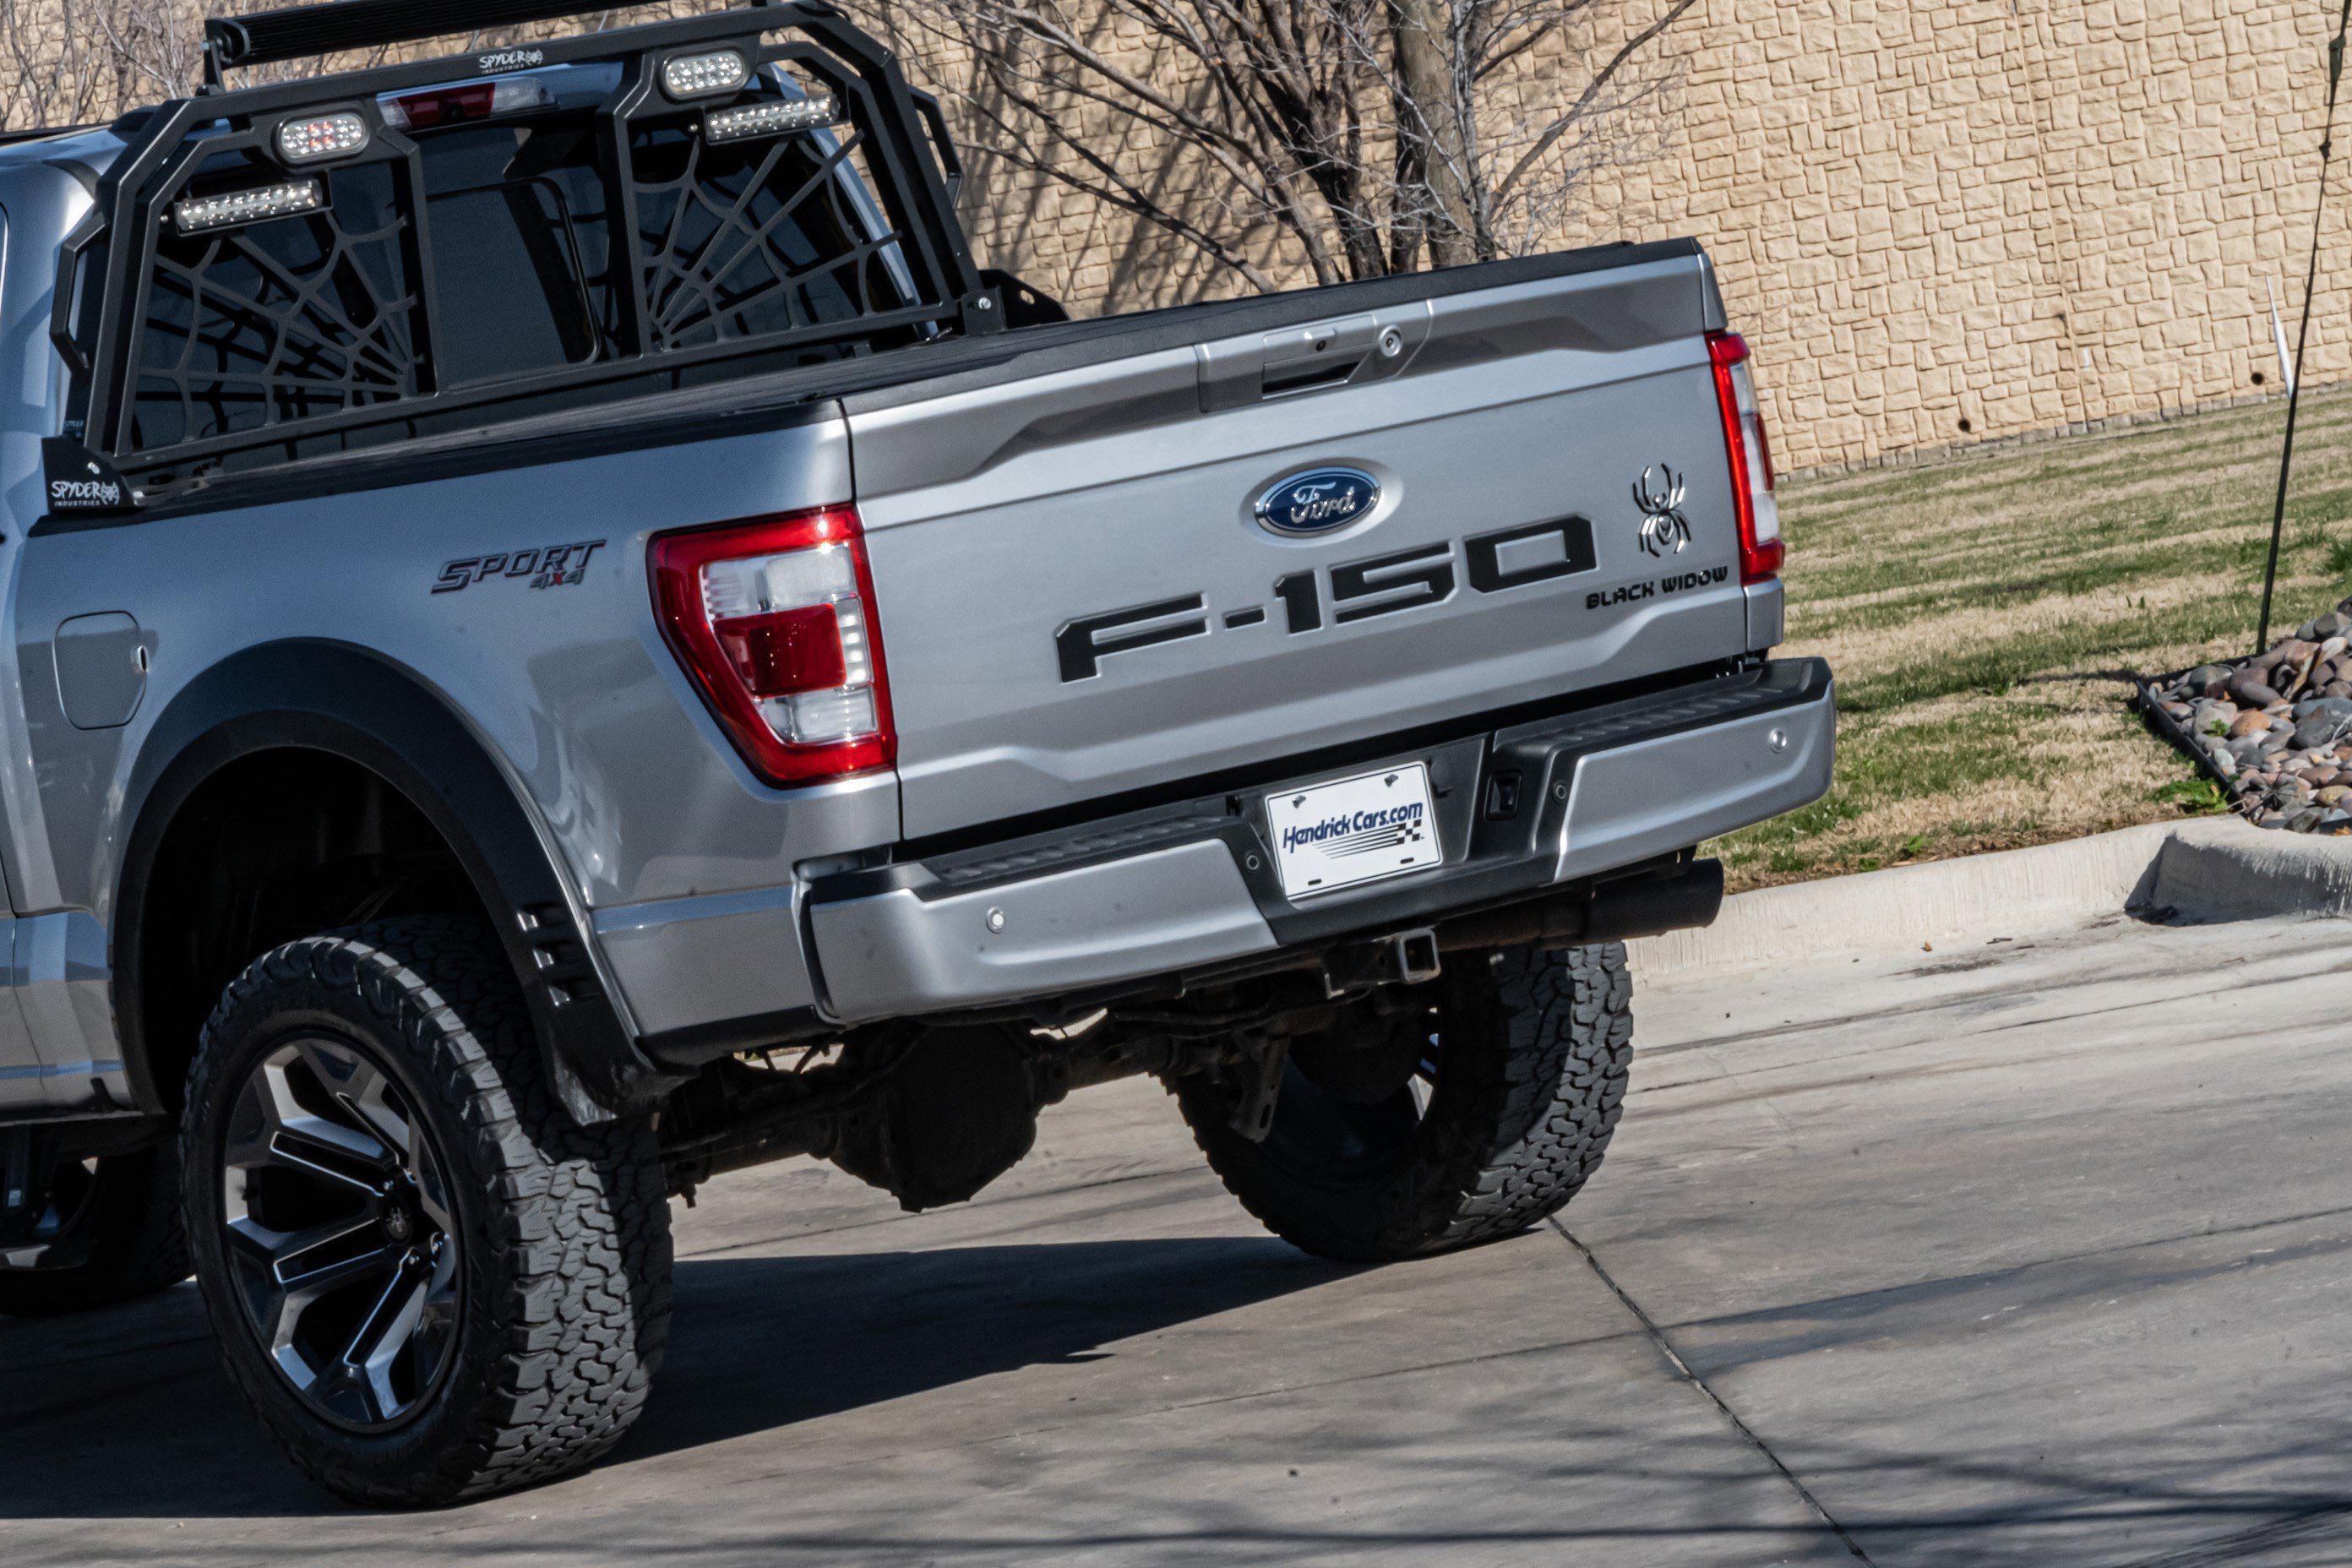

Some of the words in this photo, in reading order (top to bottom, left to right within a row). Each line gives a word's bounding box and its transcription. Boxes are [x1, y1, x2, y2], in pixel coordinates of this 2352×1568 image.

[479, 51, 525, 68] SPYDER
[52, 481, 101, 499] SPYDER
[1290, 482, 1355, 524] Ford
[431, 539, 607, 594] SPORT
[1586, 580, 1655, 609] BLACK
[1661, 565, 1728, 593] WIDOW
[1054, 513, 1598, 685] F-150
